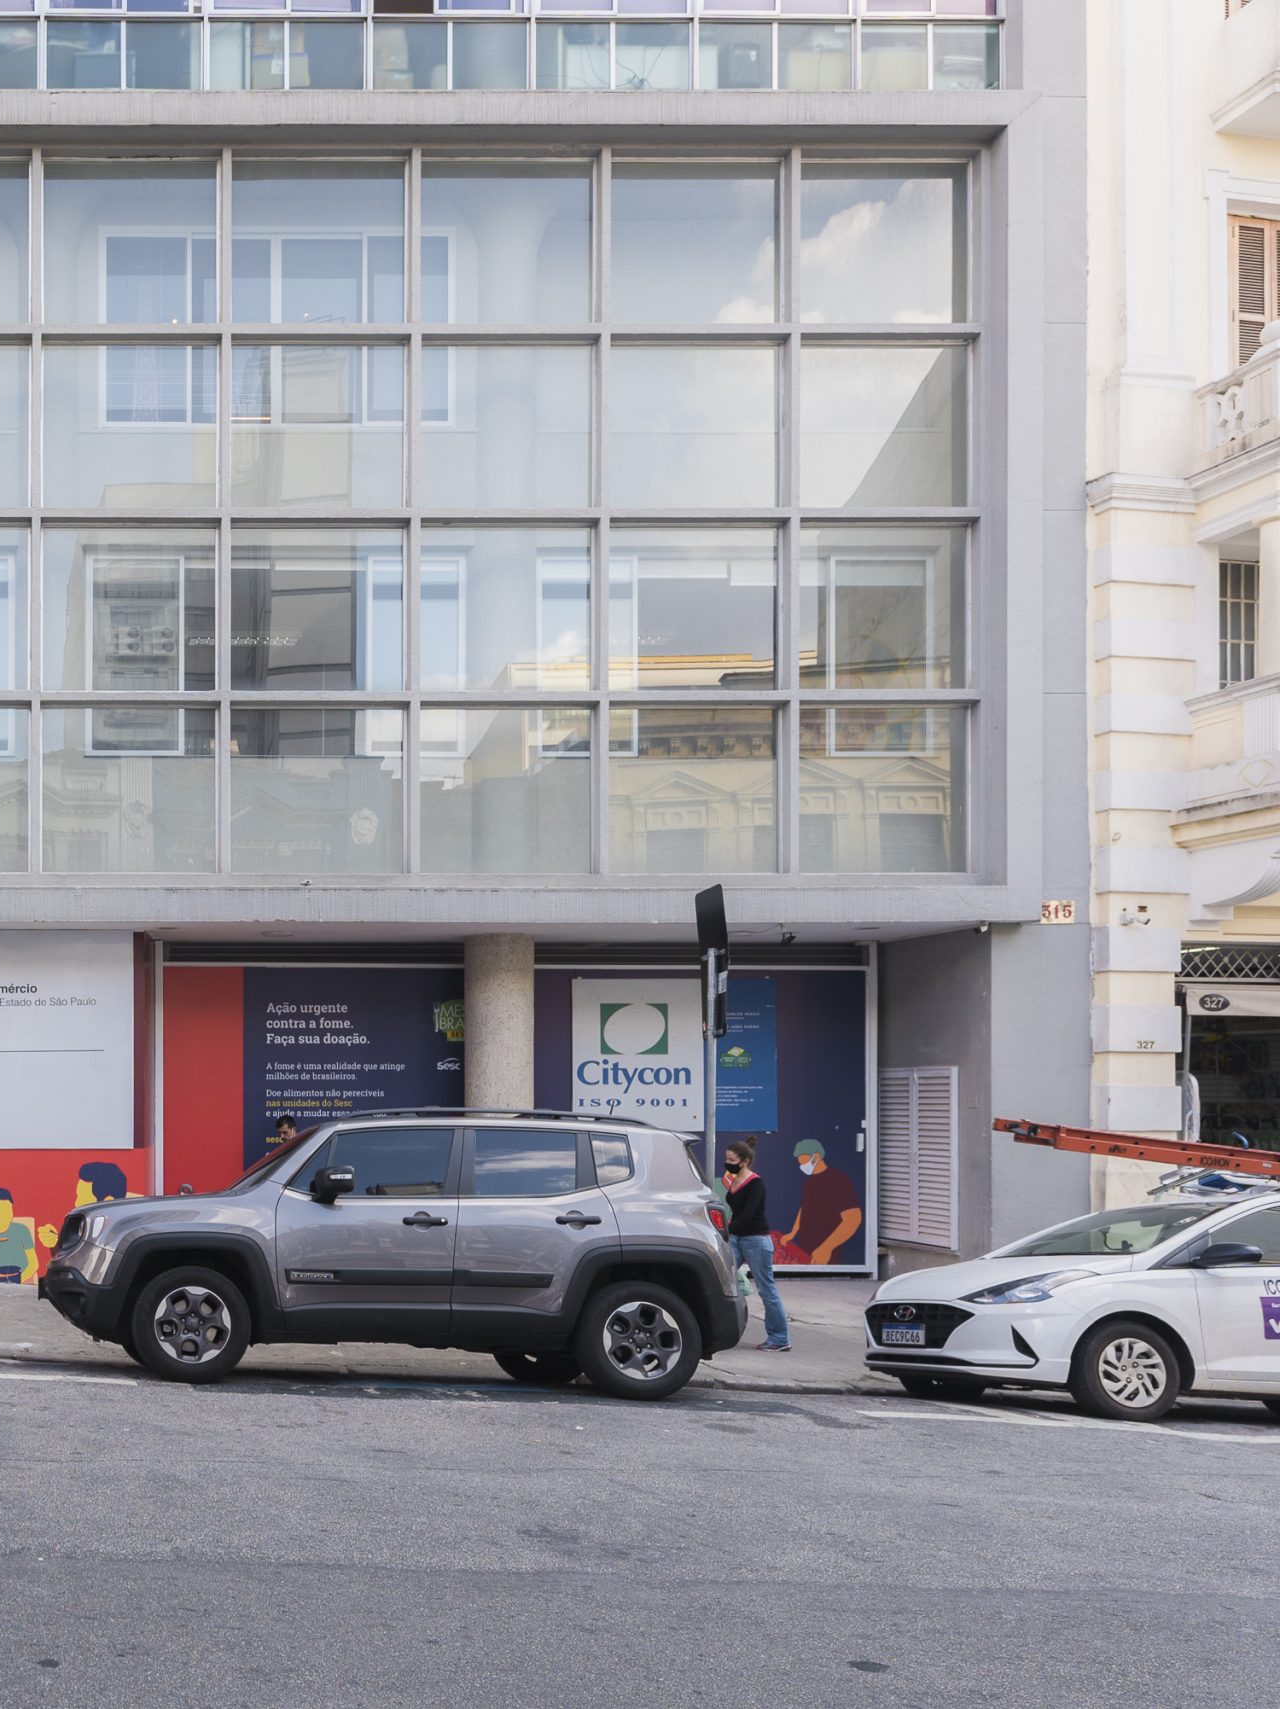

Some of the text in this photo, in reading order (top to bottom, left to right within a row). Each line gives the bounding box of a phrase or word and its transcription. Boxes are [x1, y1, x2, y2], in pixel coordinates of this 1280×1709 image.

[1042, 904, 1072, 919] 315
[0, 998, 33, 1007] Estado
[35, 997, 47, 1007] de
[49, 997, 68, 1007] São
[70, 996, 97, 1007] Paulo
[1203, 997, 1224, 1008] 327
[266, 1001, 348, 1016] Ação urgente
[440, 1003, 465, 1017] ME
[266, 1018, 354, 1029] contra a fome.
[440, 1017, 465, 1030] BRA
[266, 1033, 371, 1047] Faça sua doação.
[1136, 1040, 1155, 1049] 327
[266, 1062, 273, 1070] A
[274, 1062, 296, 1070] fome
[297, 1062, 302, 1070] é
[323, 1062, 362, 1070] realidade
[363, 1064, 378, 1072] que
[379, 1062, 406, 1072] atinge
[266, 1072, 358, 1080] milhões de brasileiros.
[577, 1058, 691, 1094] Citycon
[266, 1089, 385, 1099] Doe alimentos não perecíveis
[282, 1099, 320, 1107] unidades
[321, 1099, 333, 1107] do
[333, 1099, 353, 1107] Sesc
[578, 1098, 689, 1108] ISO 9001
[303, 1109, 330, 1117] mudar
